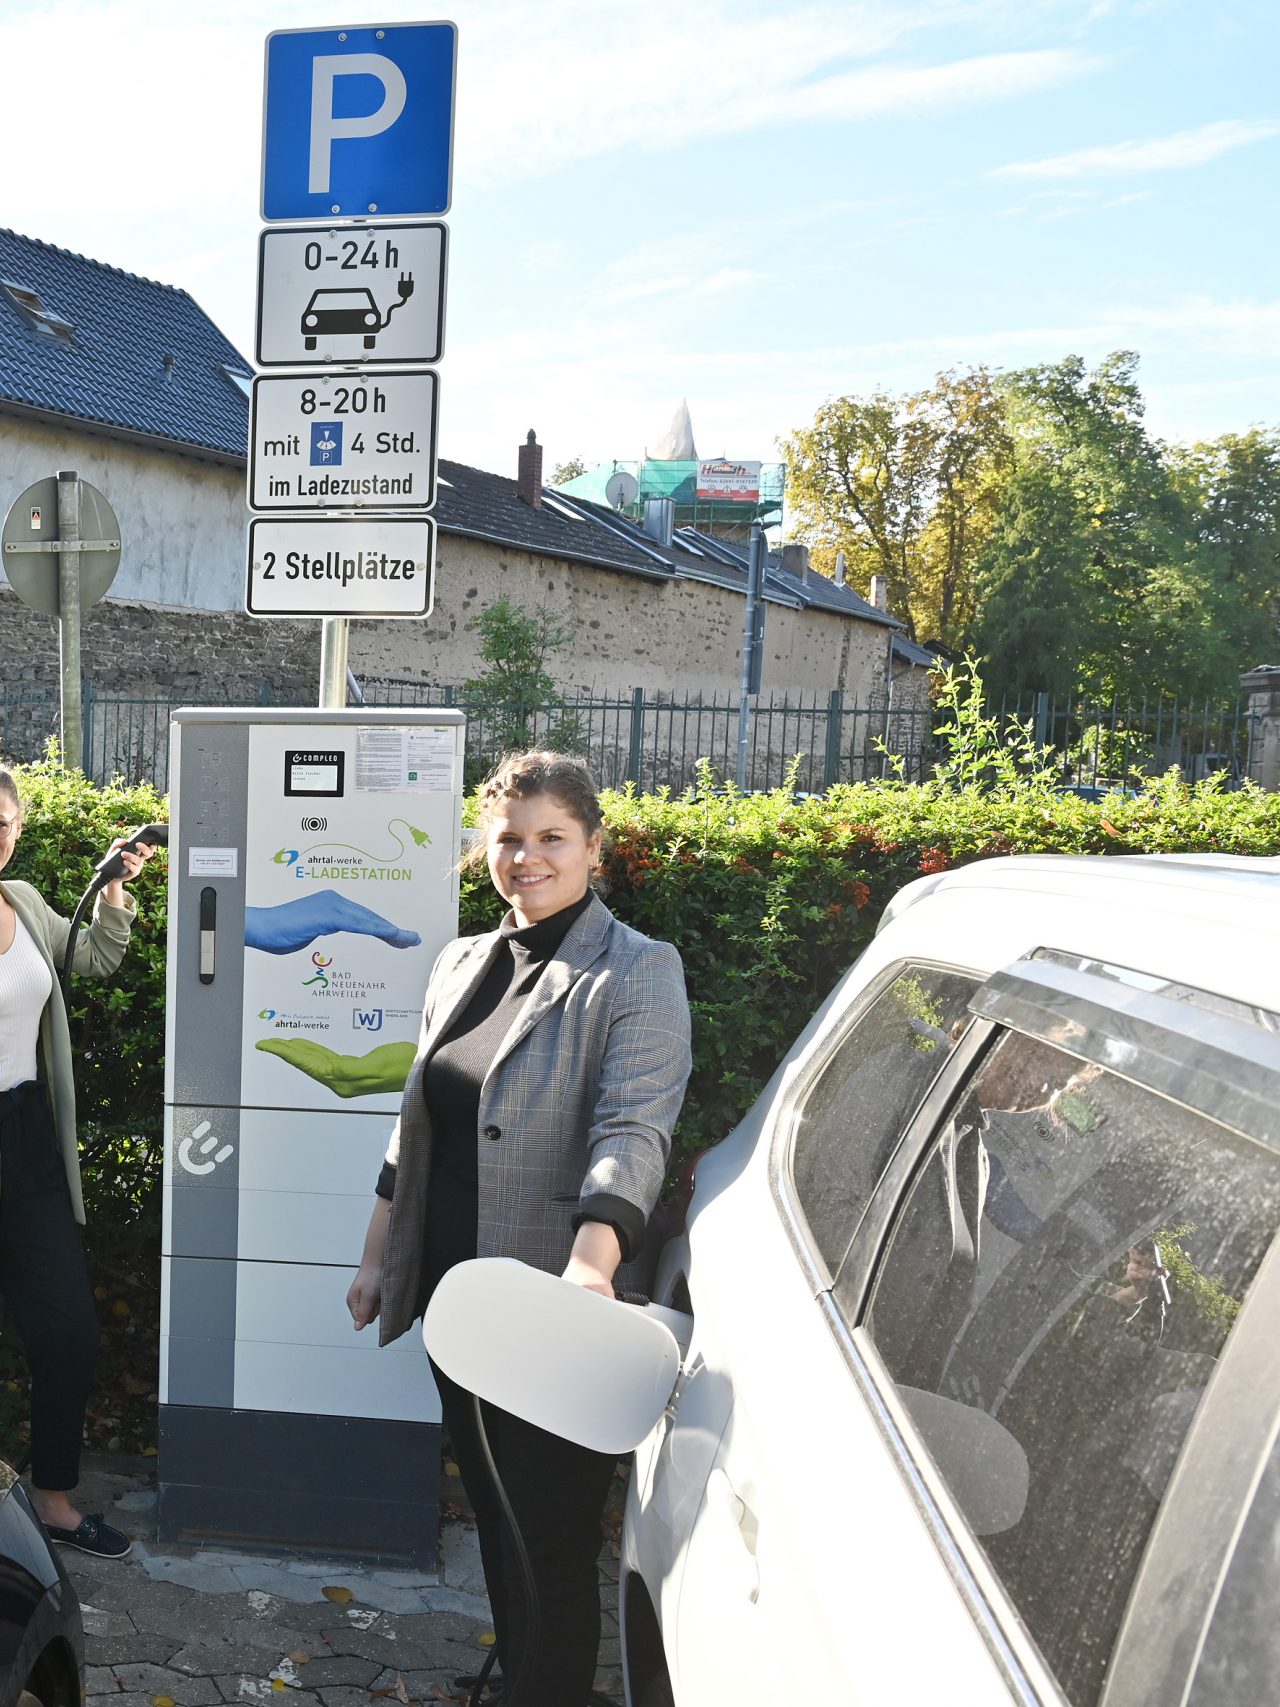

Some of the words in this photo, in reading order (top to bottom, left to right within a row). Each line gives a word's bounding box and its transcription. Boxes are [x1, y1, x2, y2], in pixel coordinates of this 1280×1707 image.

[308, 53, 407, 194] P
[264, 434, 300, 456] mit
[351, 433, 365, 454] 4
[376, 432, 420, 454] Std.
[269, 476, 290, 496] im
[298, 473, 413, 496] Ladezustand
[263, 552, 276, 580] 2
[285, 552, 415, 587] Stellplätze
[307, 856, 363, 865] ahrtal-werke
[295, 866, 412, 881] E-LADESTATION
[332, 971, 352, 979] BAD
[331, 981, 386, 990] NEUENAHR
[311, 989, 367, 998] AHRWEILER
[275, 1019, 330, 1030] ahrtal-werke
